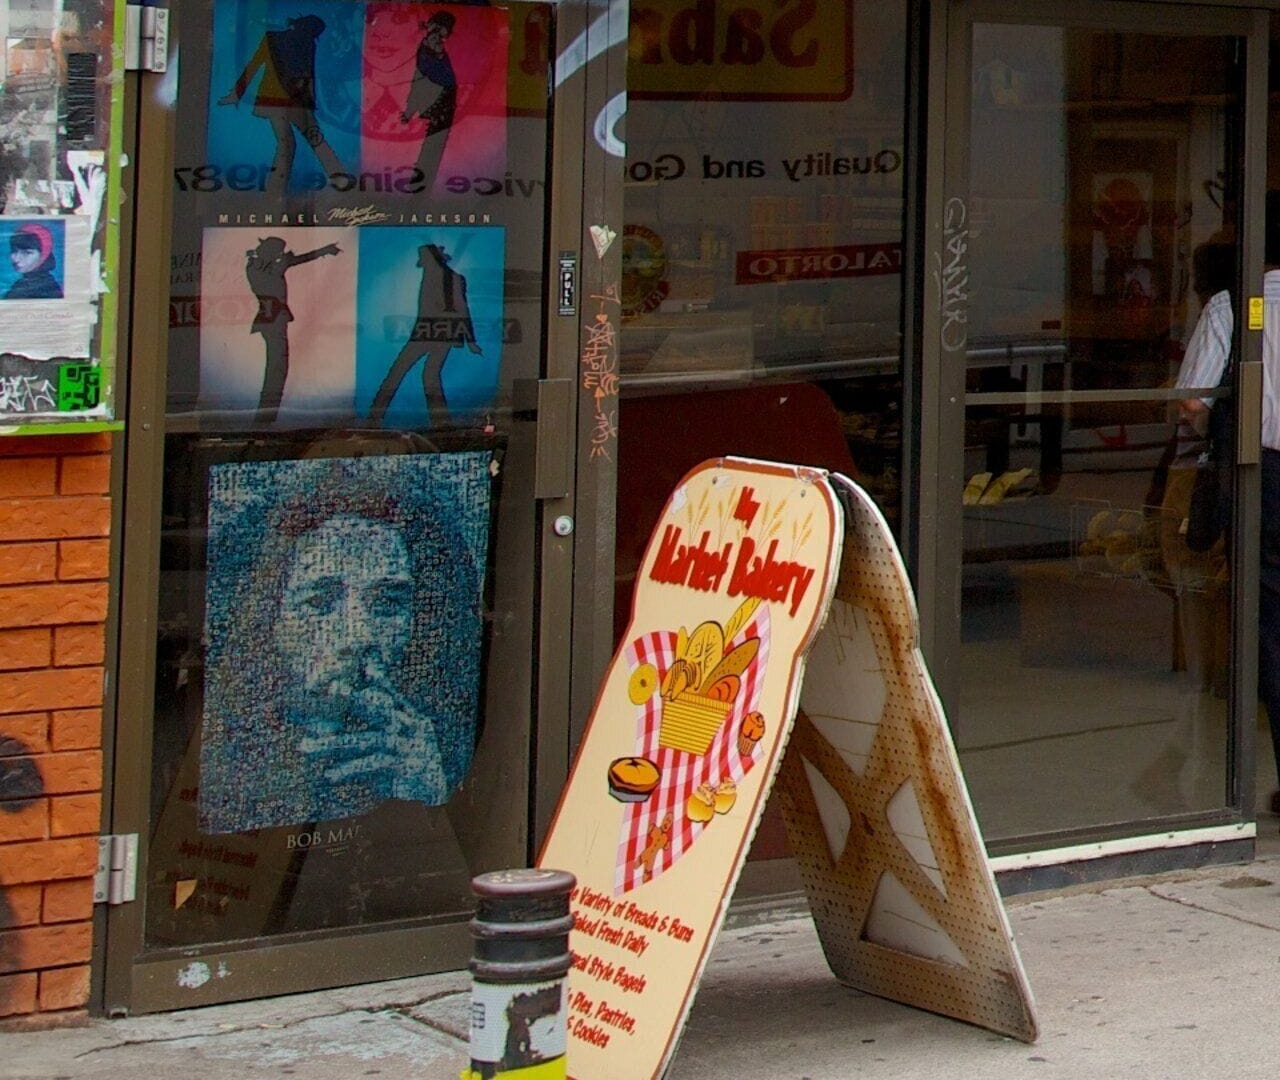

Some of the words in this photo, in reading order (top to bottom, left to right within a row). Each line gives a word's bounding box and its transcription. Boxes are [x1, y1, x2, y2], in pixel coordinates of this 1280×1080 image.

[219, 214, 319, 224] MICHAEL
[400, 213, 491, 223] JACKSON
[733, 486, 761, 530] My
[650, 524, 733, 594] Market
[727, 537, 815, 618] Bakery
[286, 828, 321, 849] BOB
[580, 887, 614, 917] Variety
[614, 901, 628, 919] of
[627, 903, 659, 932] Breads
[667, 918, 694, 943] Buns
[597, 921, 623, 947] Fresh
[622, 931, 650, 958] Daily
[588, 956, 613, 982] Style
[613, 966, 648, 994] Bagels
[573, 1019, 611, 1049] Cookies
